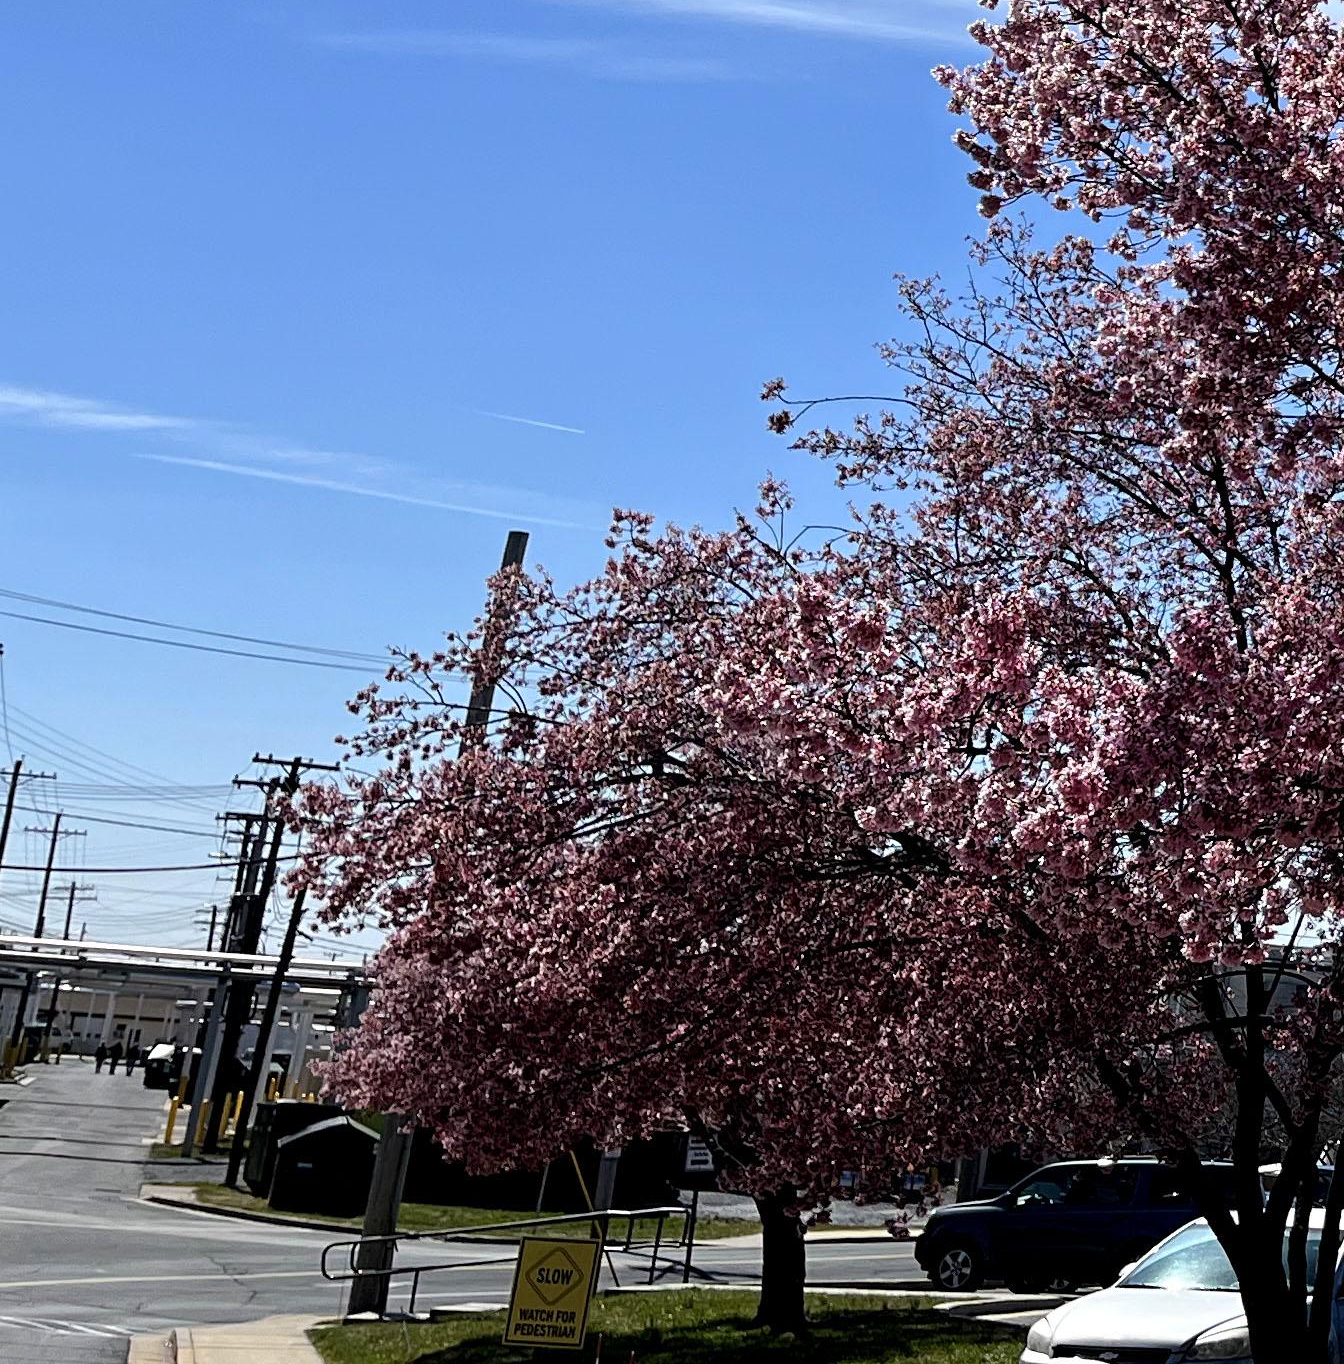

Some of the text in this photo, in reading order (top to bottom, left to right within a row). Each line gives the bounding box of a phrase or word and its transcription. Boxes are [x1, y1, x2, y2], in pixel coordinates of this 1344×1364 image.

[536, 1267, 573, 1285] SLOW
[519, 1308, 577, 1325] WATCH FOR
[514, 1323, 577, 1339] PEDESTRIAN
